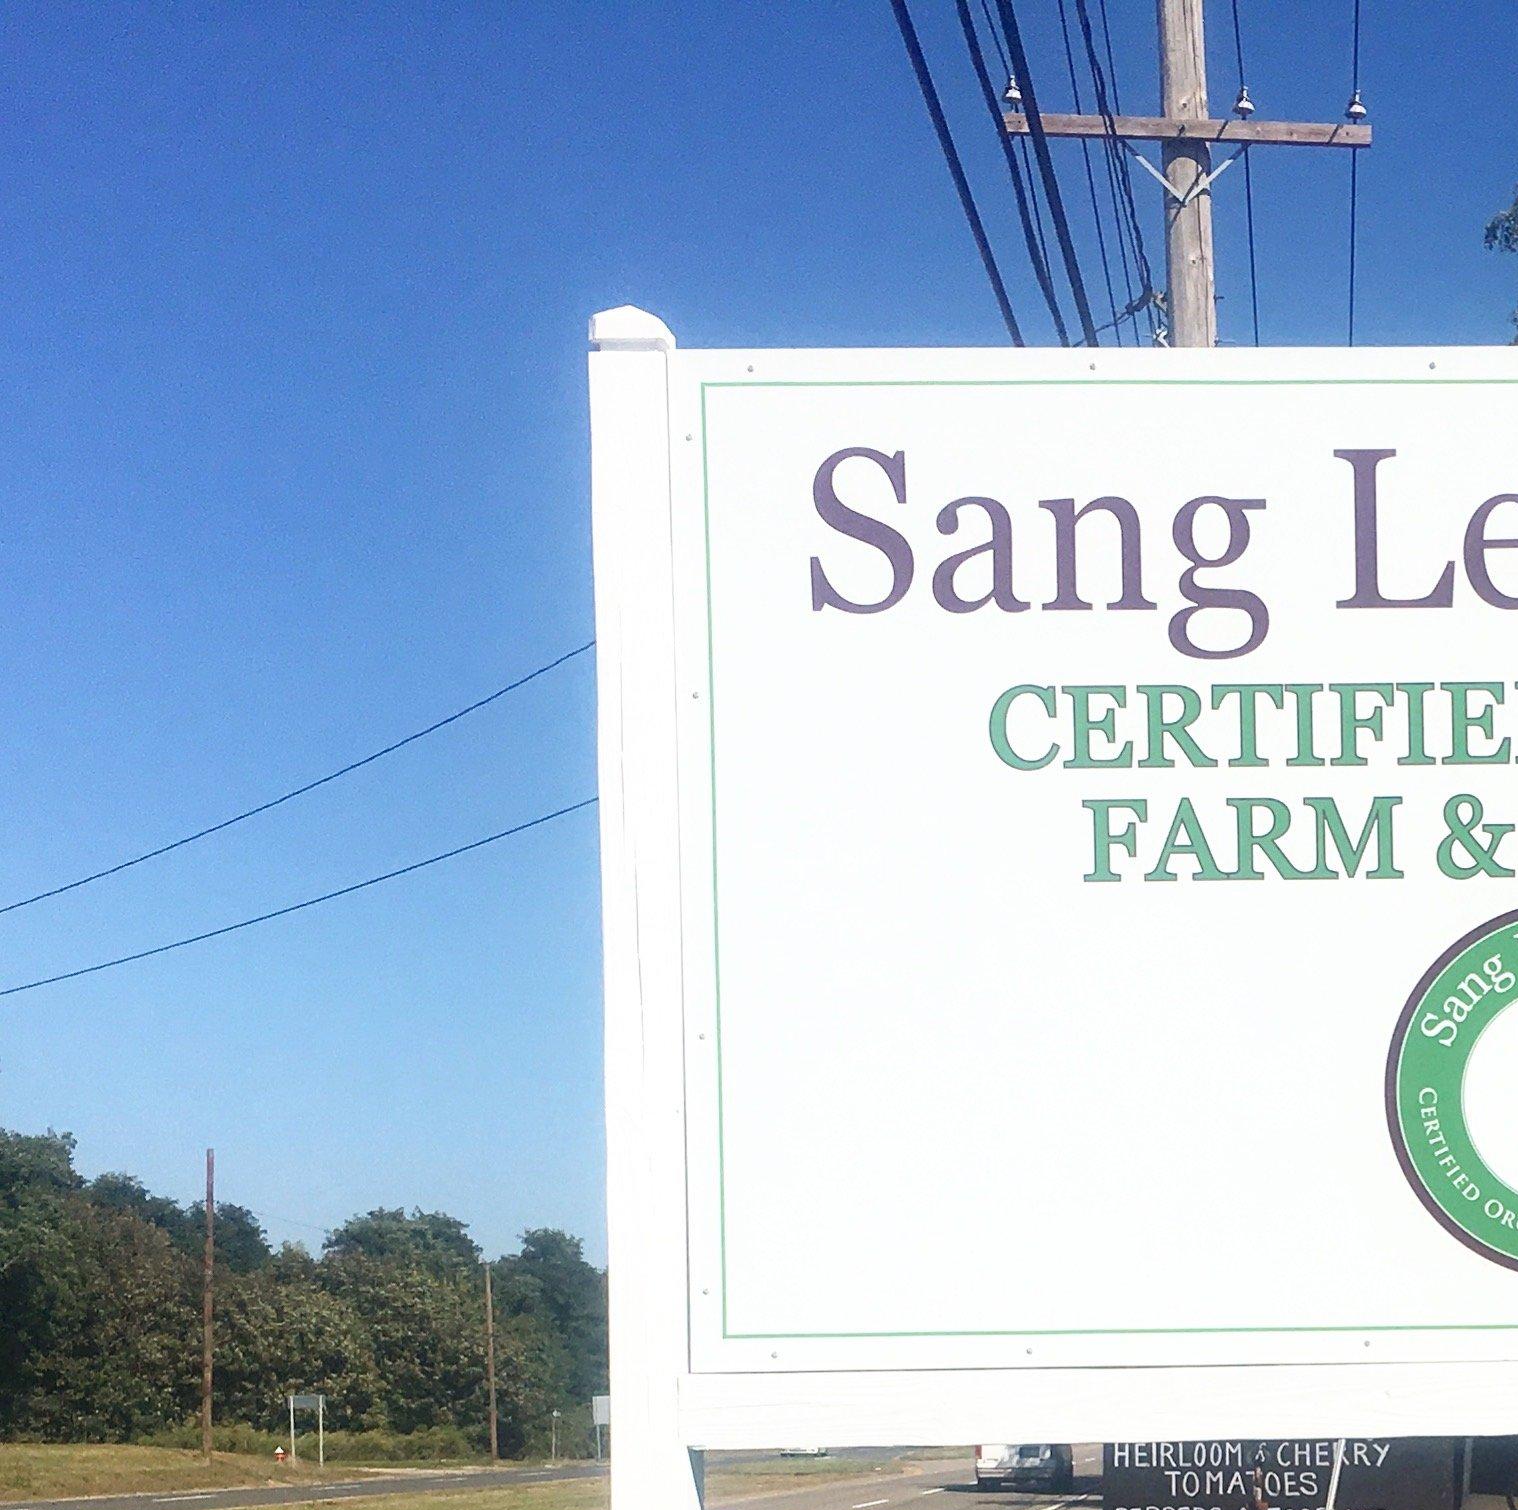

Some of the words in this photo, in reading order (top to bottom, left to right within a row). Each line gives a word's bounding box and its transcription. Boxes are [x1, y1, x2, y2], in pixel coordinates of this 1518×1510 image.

[810, 447, 1269, 659] Sang
[1082, 796, 1404, 882] FARM
[1436, 794, 1515, 880] &
[1420, 953, 1517, 1047] Sang
[1418, 1087, 1481, 1201] CERTIFIED
[1114, 1442, 1242, 1468] HEIRLOOM
